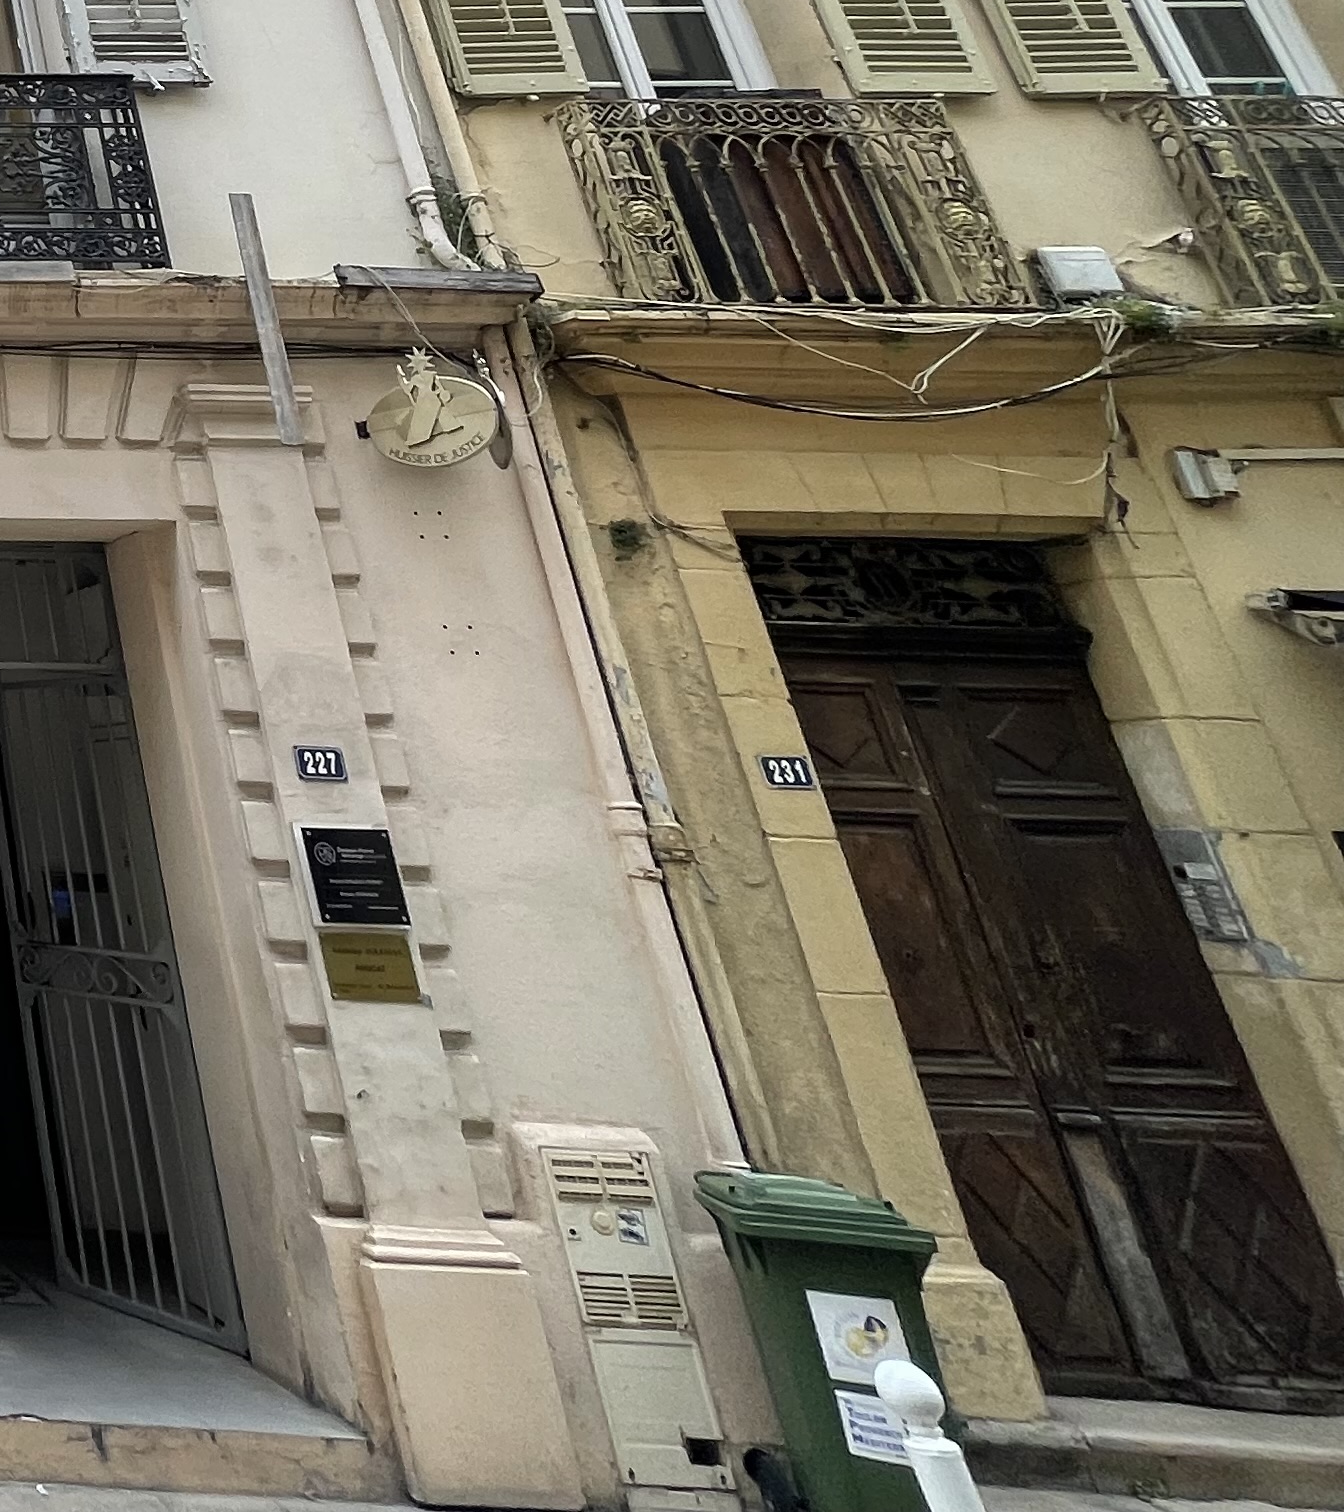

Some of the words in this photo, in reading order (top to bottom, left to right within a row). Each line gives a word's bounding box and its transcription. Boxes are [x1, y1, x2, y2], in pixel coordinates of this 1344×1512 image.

[389, 448, 432, 465] HUISSIER
[433, 452, 448, 464] DE
[452, 431, 485, 460] JUSTICE
[303, 751, 337, 775] 227
[768, 760, 807, 784] 231
